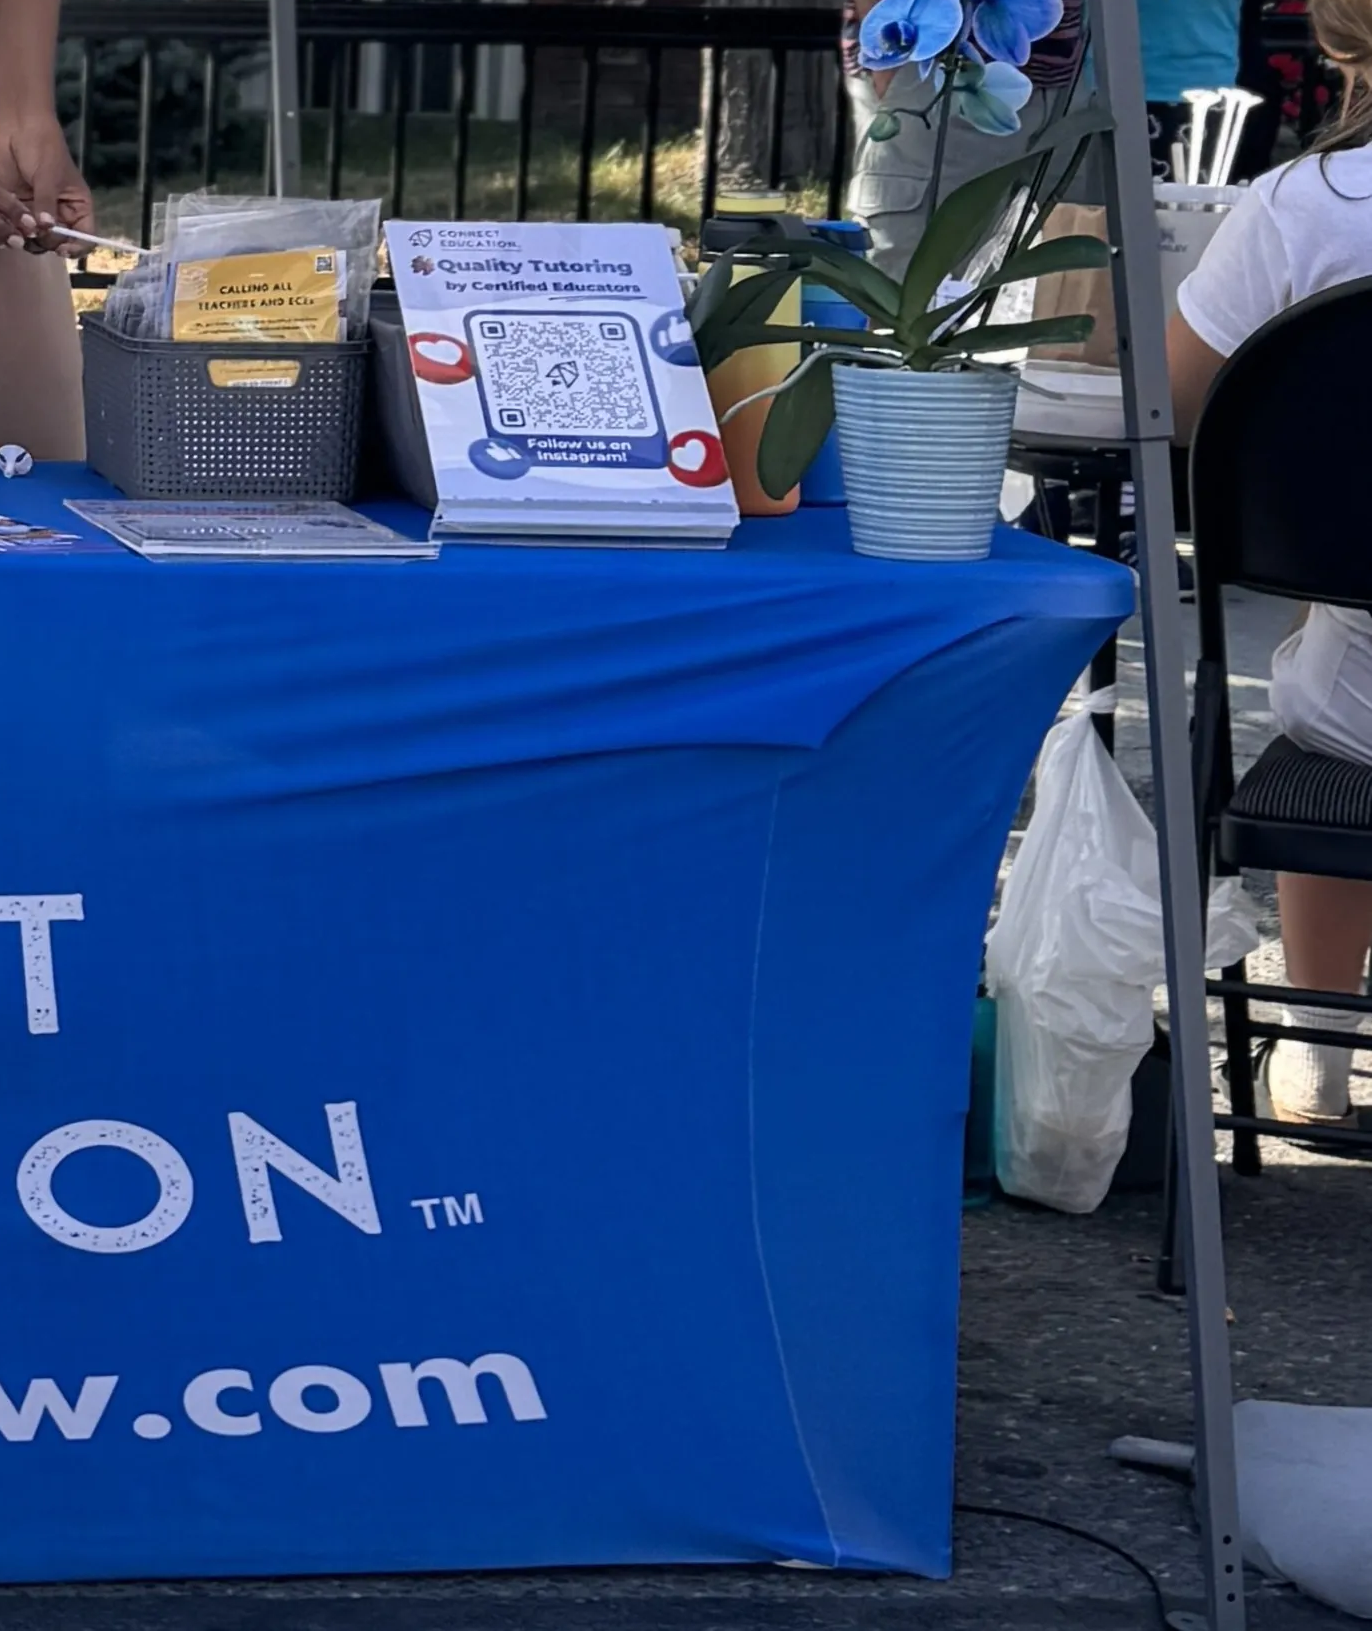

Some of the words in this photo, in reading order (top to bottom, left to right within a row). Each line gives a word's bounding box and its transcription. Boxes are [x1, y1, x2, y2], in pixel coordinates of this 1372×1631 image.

[438, 229, 500, 239] CONNECT
[437, 258, 523, 275] Quality
[528, 259, 633, 276] Tutoring
[445, 280, 467, 292] by
[471, 280, 548, 292] Certified
[552, 281, 641, 293] Educators
[527, 438, 582, 449] Follow
[587, 440, 607, 450] us
[537, 451, 628, 463] Instagram!
